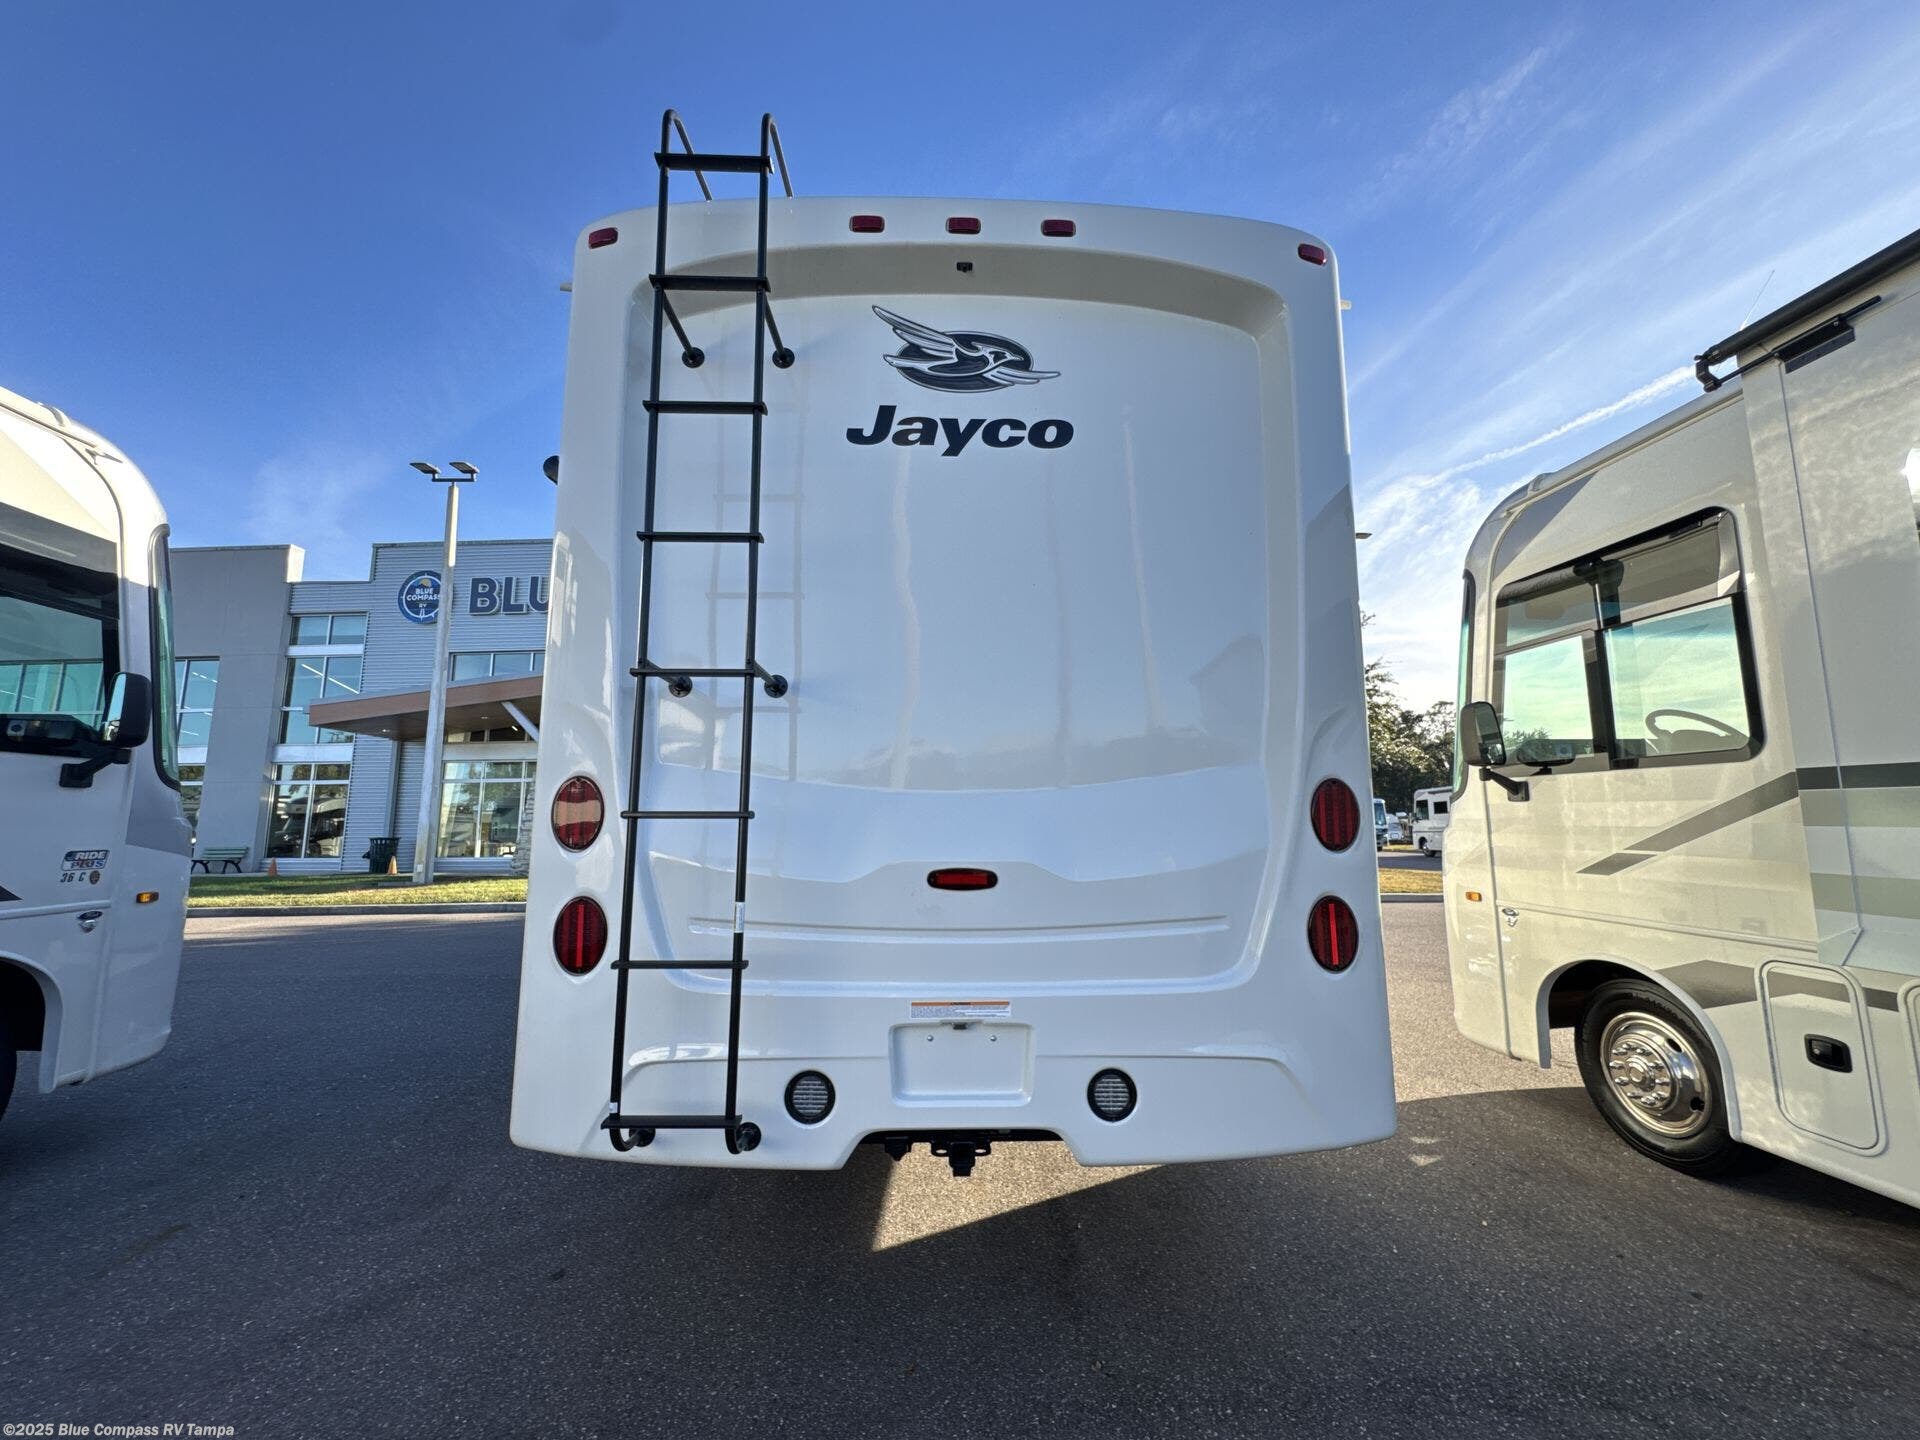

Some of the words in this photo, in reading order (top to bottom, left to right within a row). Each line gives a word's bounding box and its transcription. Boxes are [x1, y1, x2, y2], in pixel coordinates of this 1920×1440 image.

[846, 405, 1074, 457] Jayco
[70, 860, 104, 869] PLUS
[60, 872, 76, 883] 36
